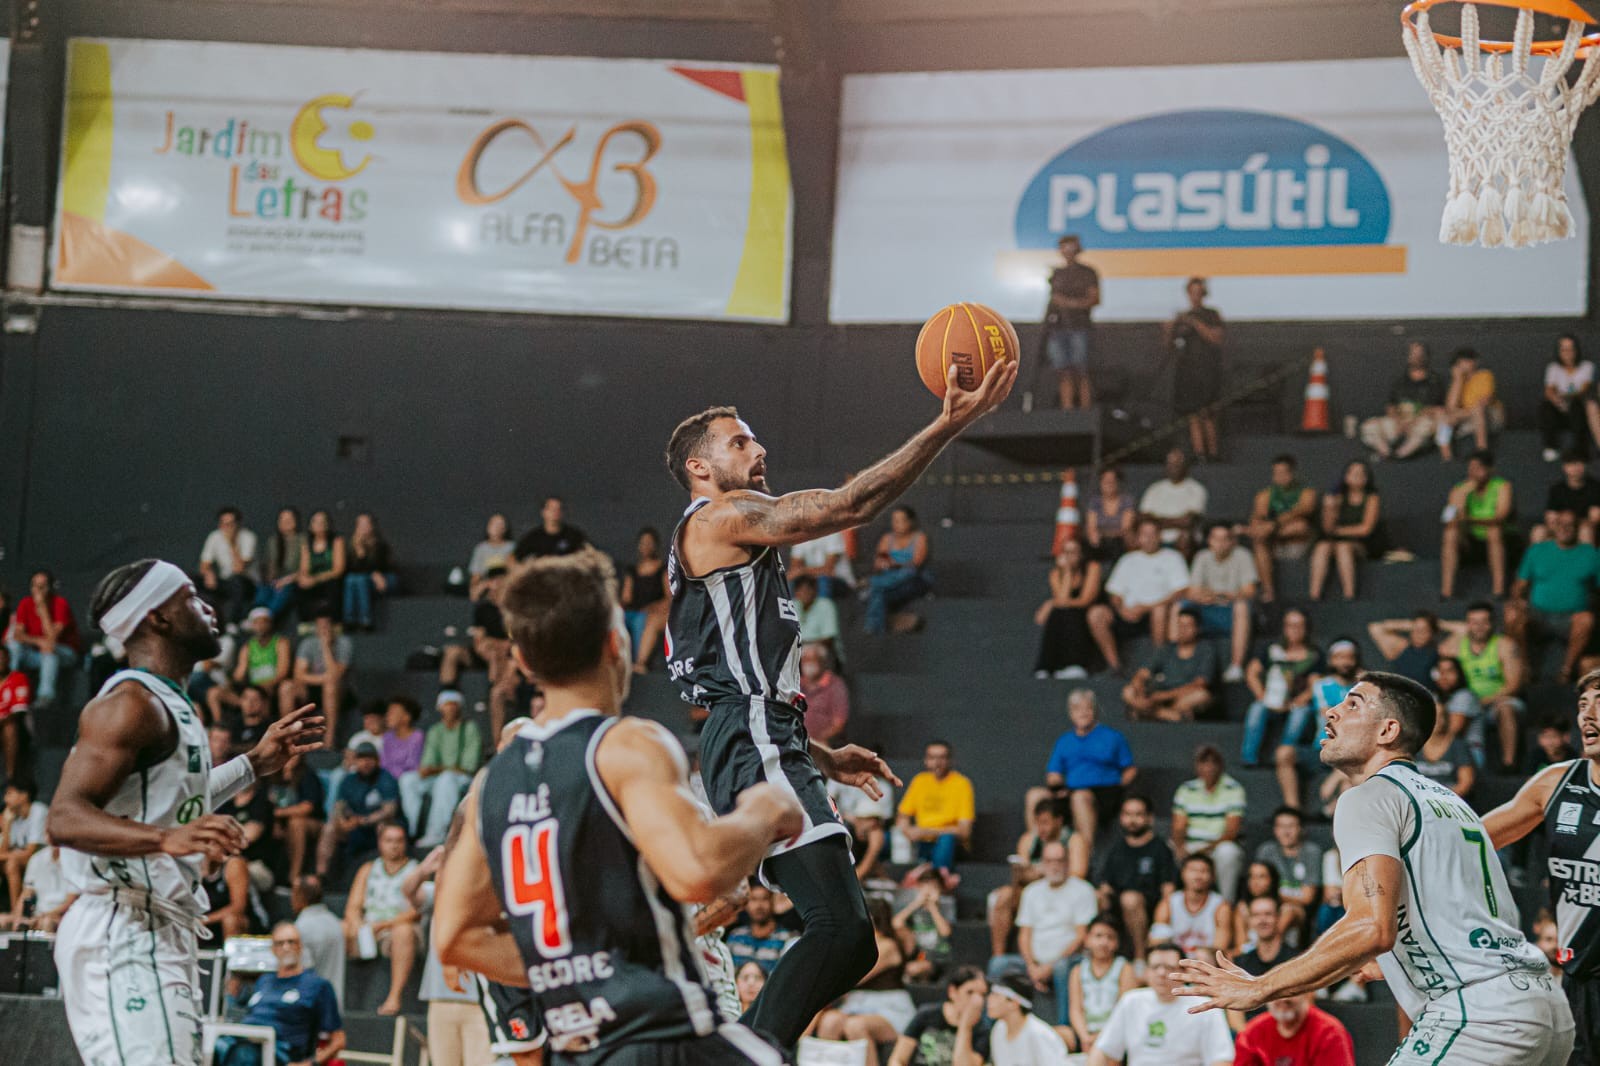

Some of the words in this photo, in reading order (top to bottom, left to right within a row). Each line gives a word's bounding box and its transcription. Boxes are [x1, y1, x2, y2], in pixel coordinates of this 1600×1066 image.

[155, 110, 282, 158] Jardim
[229, 164, 368, 222] Letras
[480, 212, 566, 246] ALFA
[587, 235, 680, 269] BETA
[984, 325, 1007, 361] PEN
[502, 817, 573, 958] 4
[1460, 826, 1498, 918] 7
[1548, 857, 1600, 884] ESTR
[528, 951, 615, 993] SCORE
